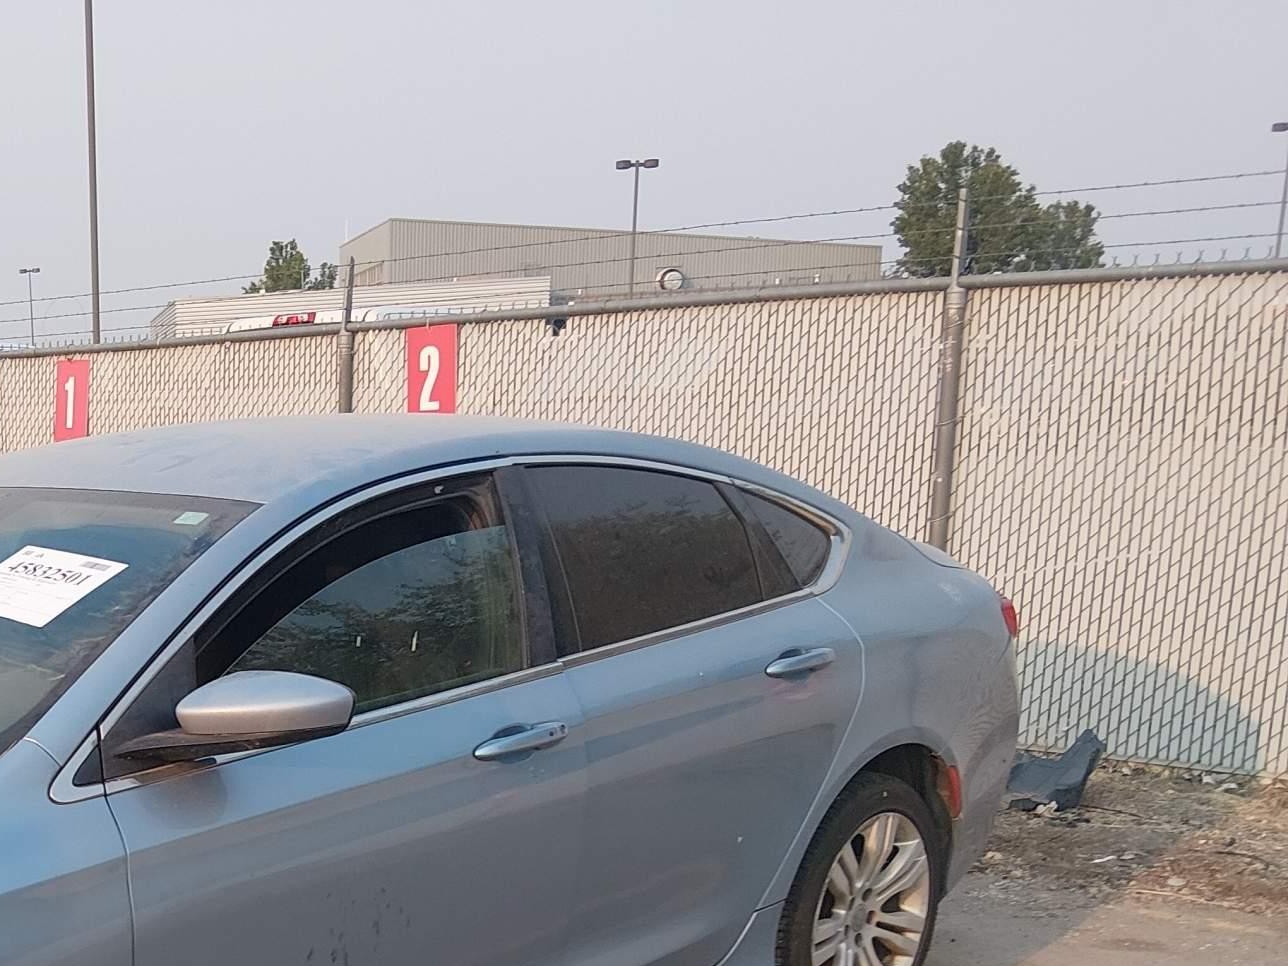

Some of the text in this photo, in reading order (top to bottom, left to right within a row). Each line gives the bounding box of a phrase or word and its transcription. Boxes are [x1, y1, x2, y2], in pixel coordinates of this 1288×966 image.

[64, 376, 75, 429] 1
[419, 345, 440, 411] 2
[8, 561, 93, 586] 45832501
